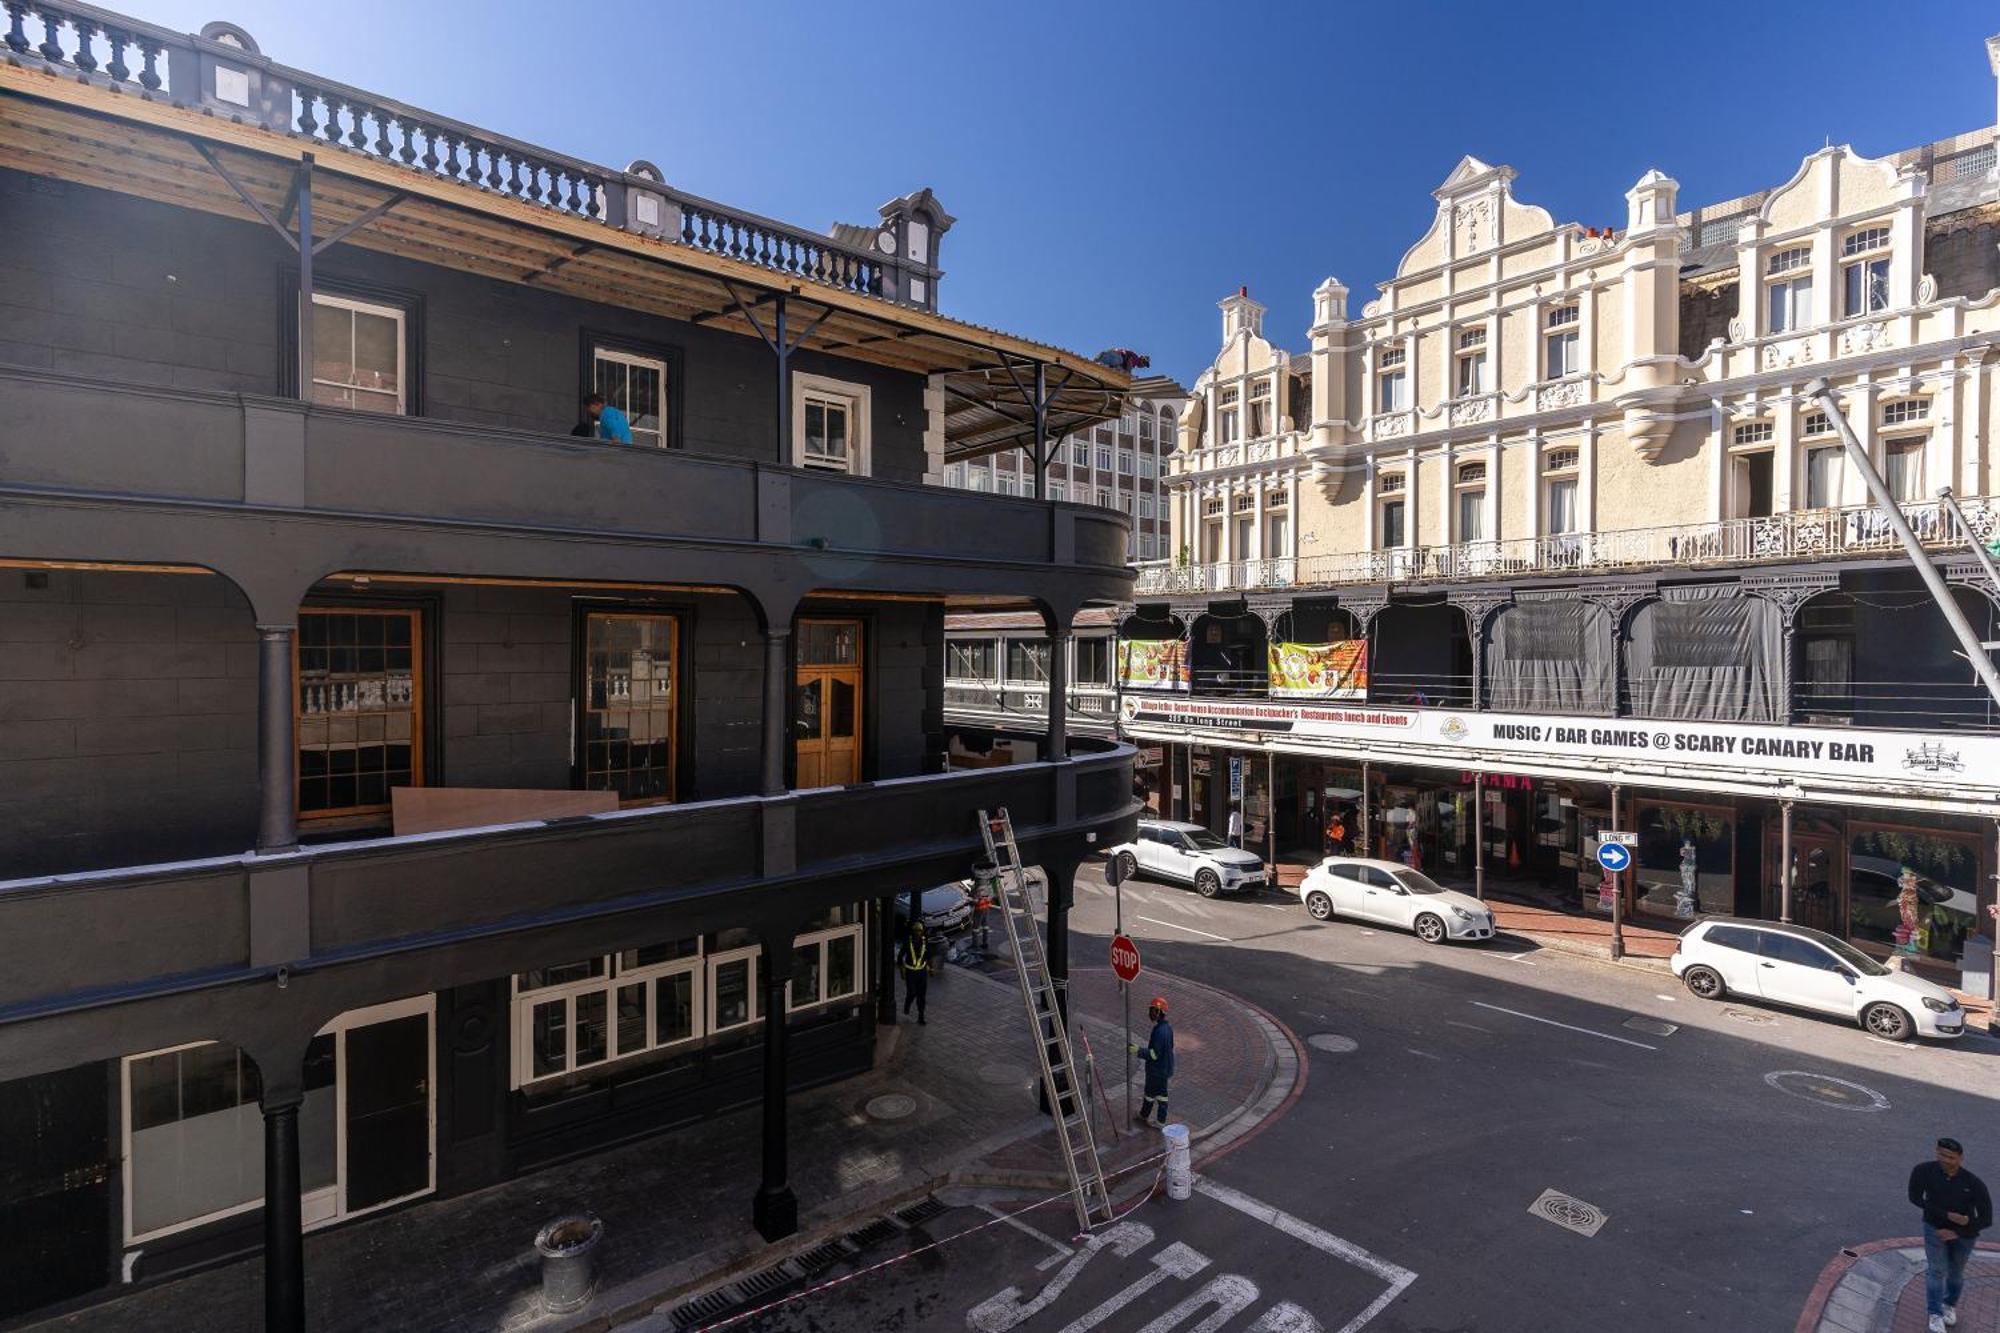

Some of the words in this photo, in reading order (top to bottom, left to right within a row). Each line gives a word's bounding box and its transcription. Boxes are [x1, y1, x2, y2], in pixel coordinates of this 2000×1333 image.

[1216, 718, 1242, 727] Street
[1301, 709, 1343, 722] Restaurants
[1366, 713, 1381, 724] and
[1382, 713, 1408, 726] Events
[1493, 724, 1541, 741] MUSIC
[1544, 726, 1552, 742] /
[1556, 728, 1587, 744] BAR
[1591, 729, 1649, 748] GAMES
[1652, 732, 1671, 749] @
[1674, 734, 1737, 753] SCARY
[1741, 737, 1824, 760] CANARY
[1829, 742, 1875, 763] BAR
[1604, 834, 1624, 843] LONG
[1112, 946, 1137, 970] STOP
